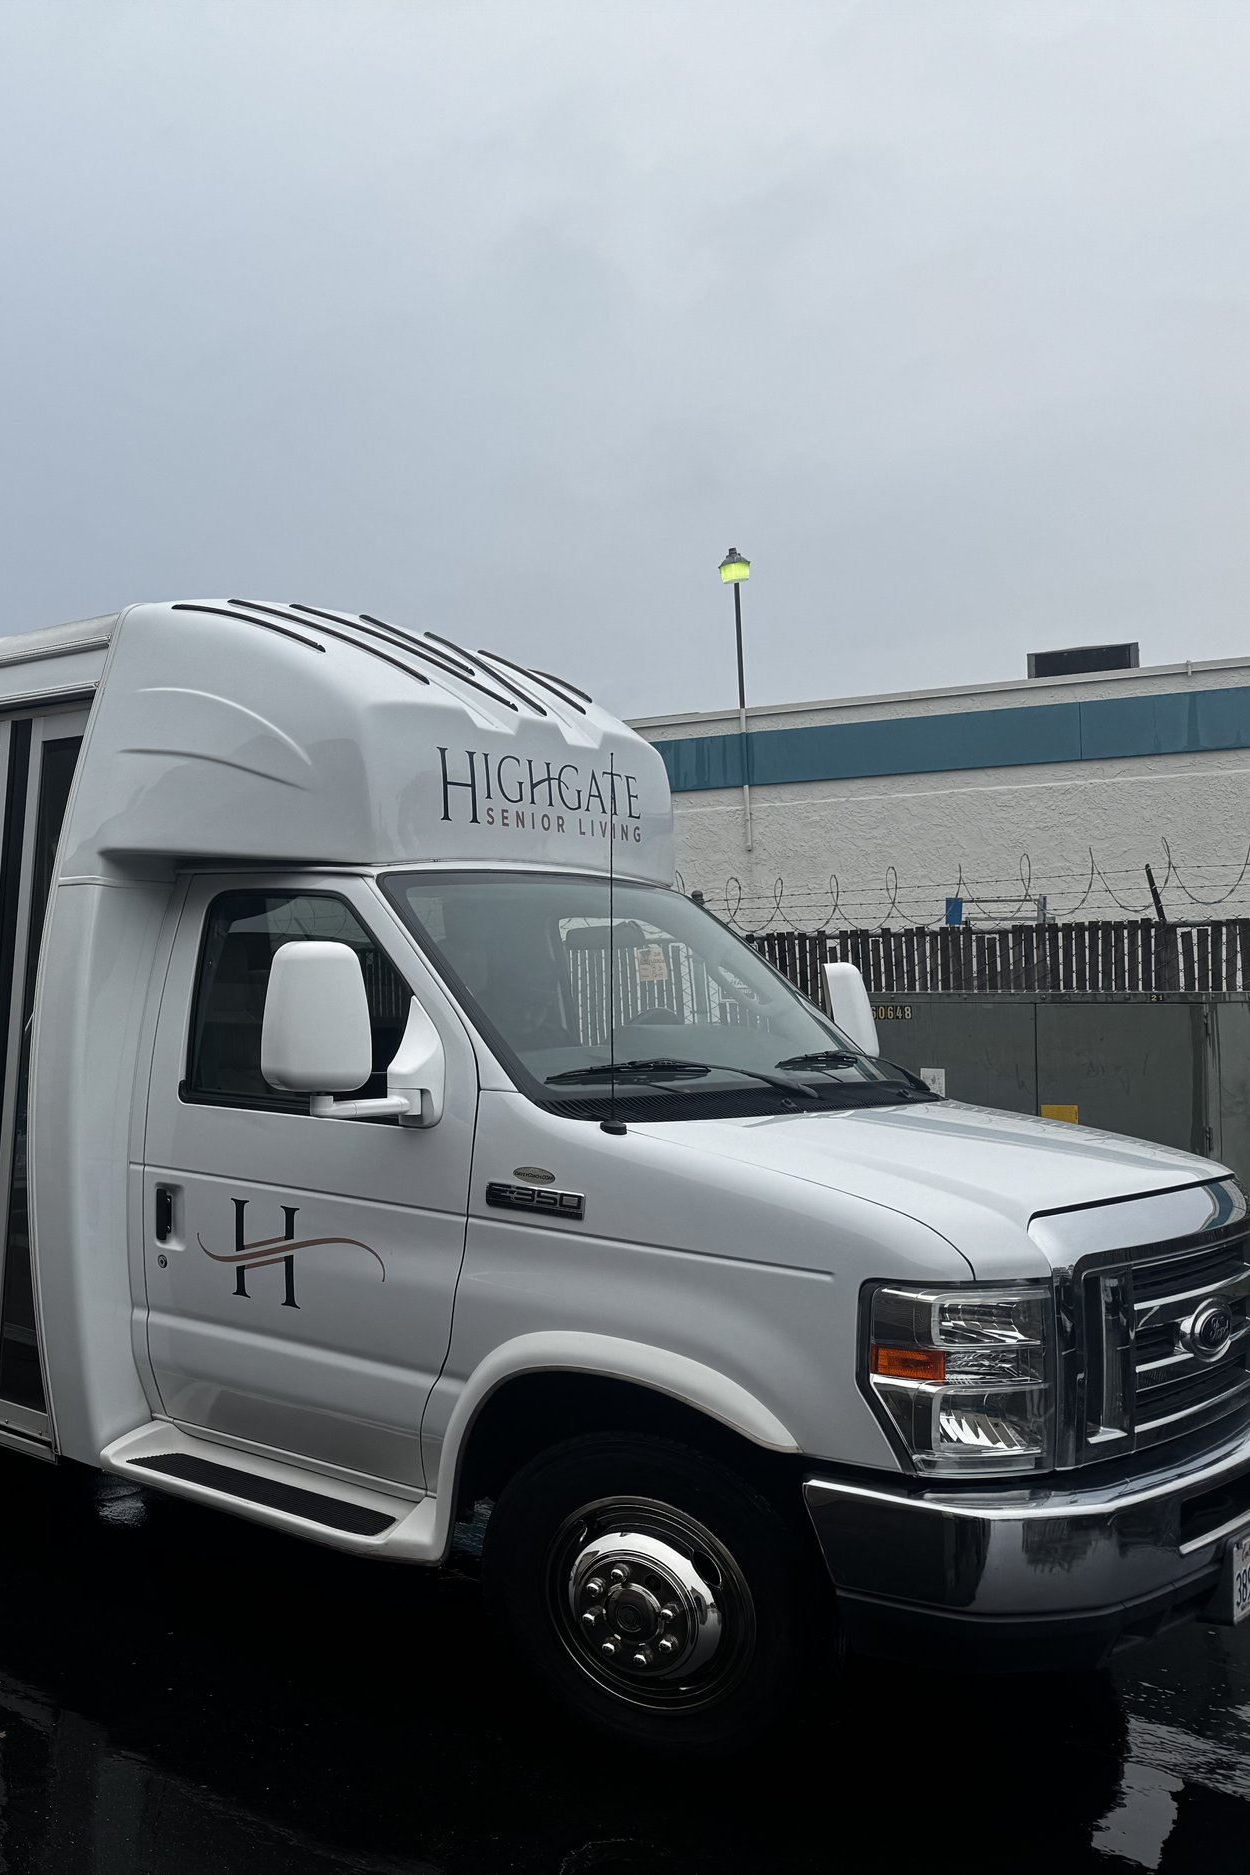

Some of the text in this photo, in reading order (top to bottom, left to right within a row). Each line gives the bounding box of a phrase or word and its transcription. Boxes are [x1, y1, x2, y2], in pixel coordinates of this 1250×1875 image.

[436, 746, 642, 824] HIGHGATE
[486, 807, 642, 843] SENIOR LIVING
[1210, 1317, 1230, 1340] Ford
